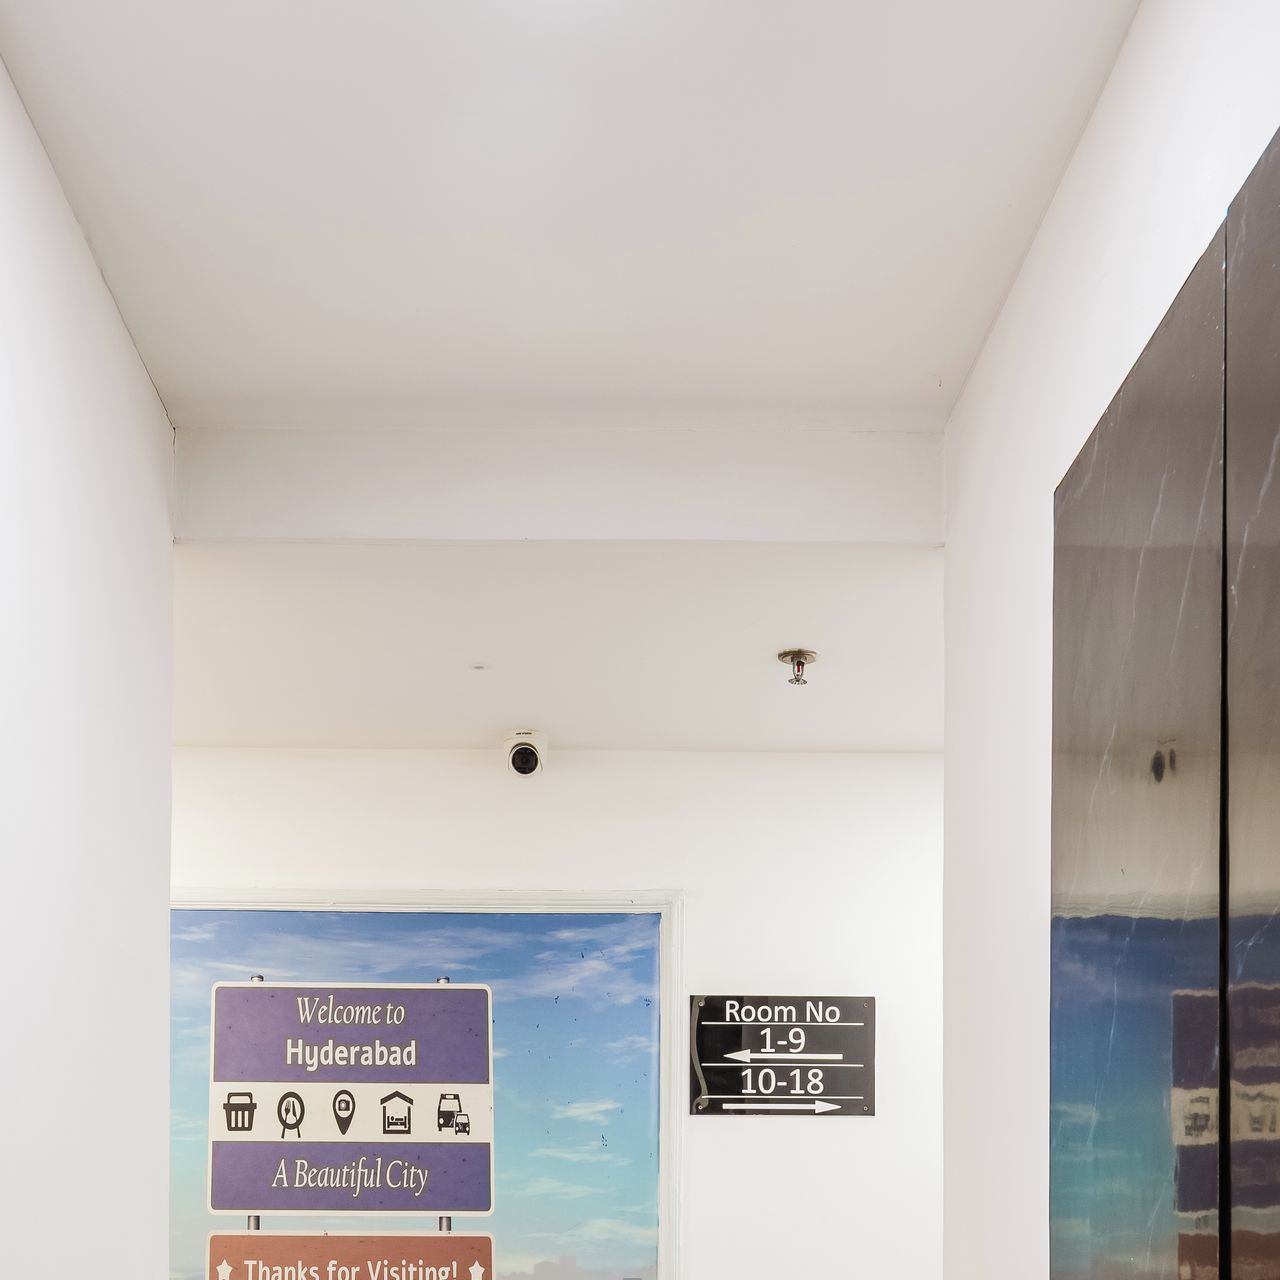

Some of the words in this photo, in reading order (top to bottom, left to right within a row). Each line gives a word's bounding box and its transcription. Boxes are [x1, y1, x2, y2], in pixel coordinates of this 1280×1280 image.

[296, 995, 382, 1025] Welcome
[385, 1000, 405, 1025] to
[725, 1000, 796, 1022] Room
[806, 1001, 841, 1023] No
[760, 1027, 806, 1053] 1-9
[285, 1038, 417, 1072] Hyderabad
[741, 1068, 825, 1095] 10-18
[272, 1160, 290, 1188] A
[294, 1157, 383, 1197] Beautiful
[386, 1157, 428, 1196] City
